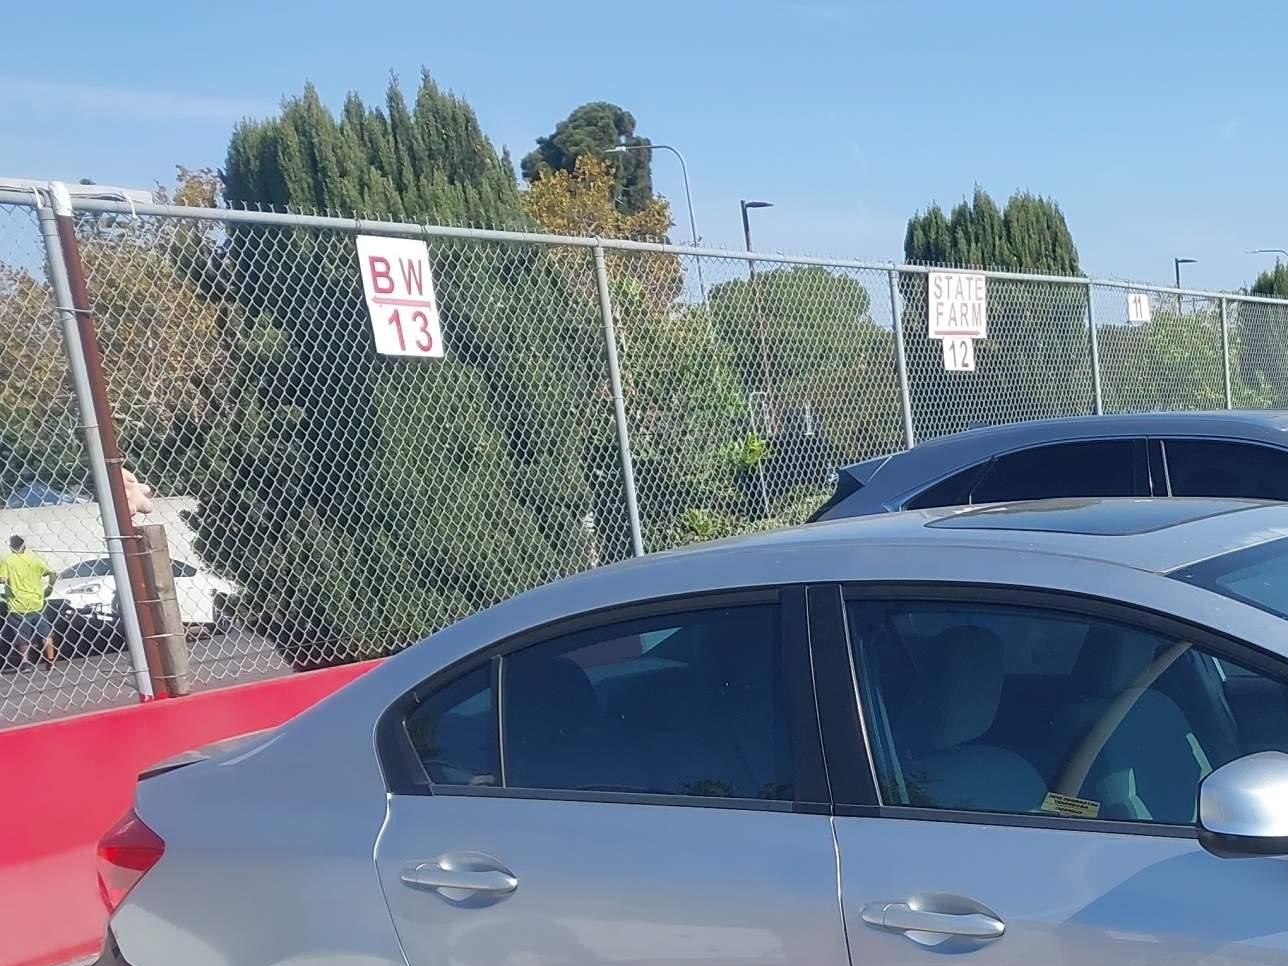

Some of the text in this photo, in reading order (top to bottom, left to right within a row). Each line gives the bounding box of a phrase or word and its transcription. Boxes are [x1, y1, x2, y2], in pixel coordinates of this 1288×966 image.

[368, 255, 424, 296] BW
[933, 275, 983, 301] STATE
[936, 302, 982, 327] FARM
[388, 309, 433, 352] 13
[949, 340, 970, 368] 12
